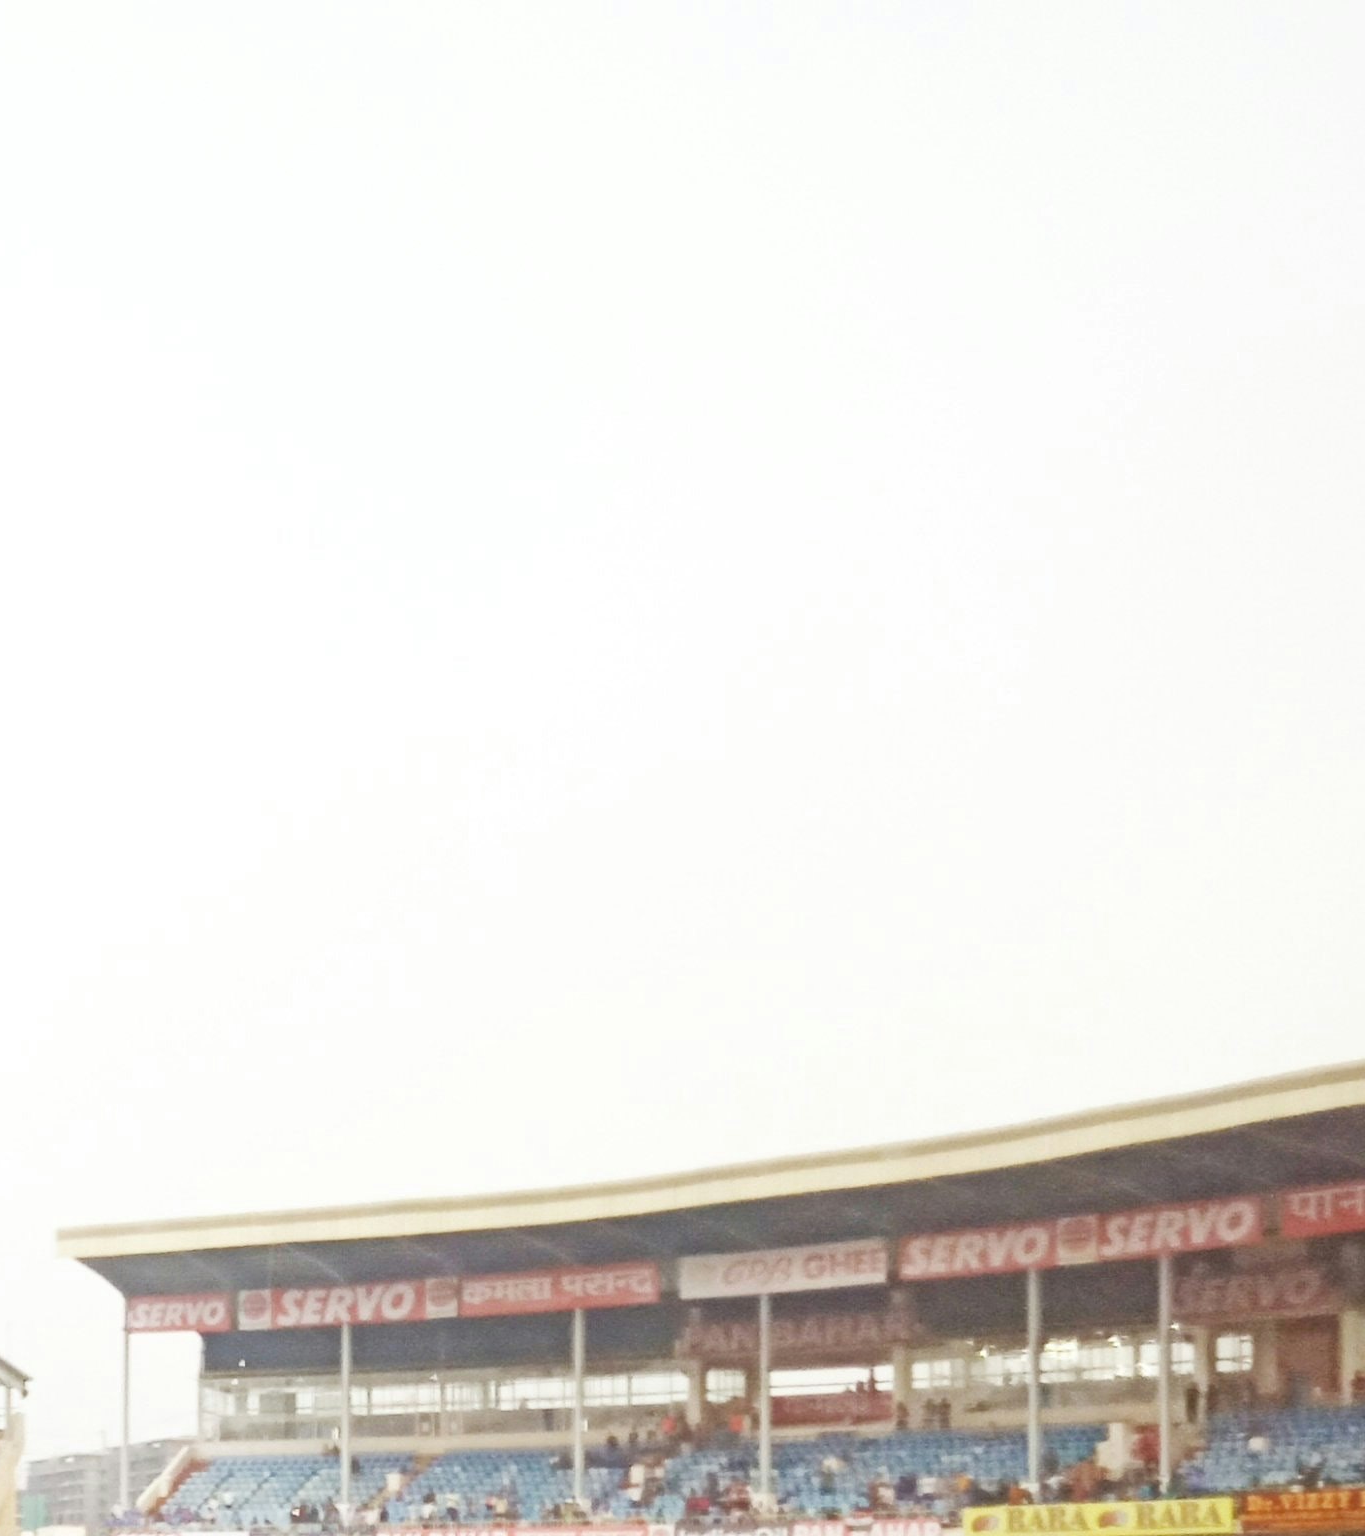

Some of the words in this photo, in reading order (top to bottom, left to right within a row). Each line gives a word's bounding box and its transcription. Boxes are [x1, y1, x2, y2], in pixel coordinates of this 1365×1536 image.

[900, 1226, 1049, 1277] SERVO
[1100, 1201, 1256, 1257] SERVO
[128, 1300, 226, 1329] SERVO
[276, 1283, 416, 1326] SERVO
